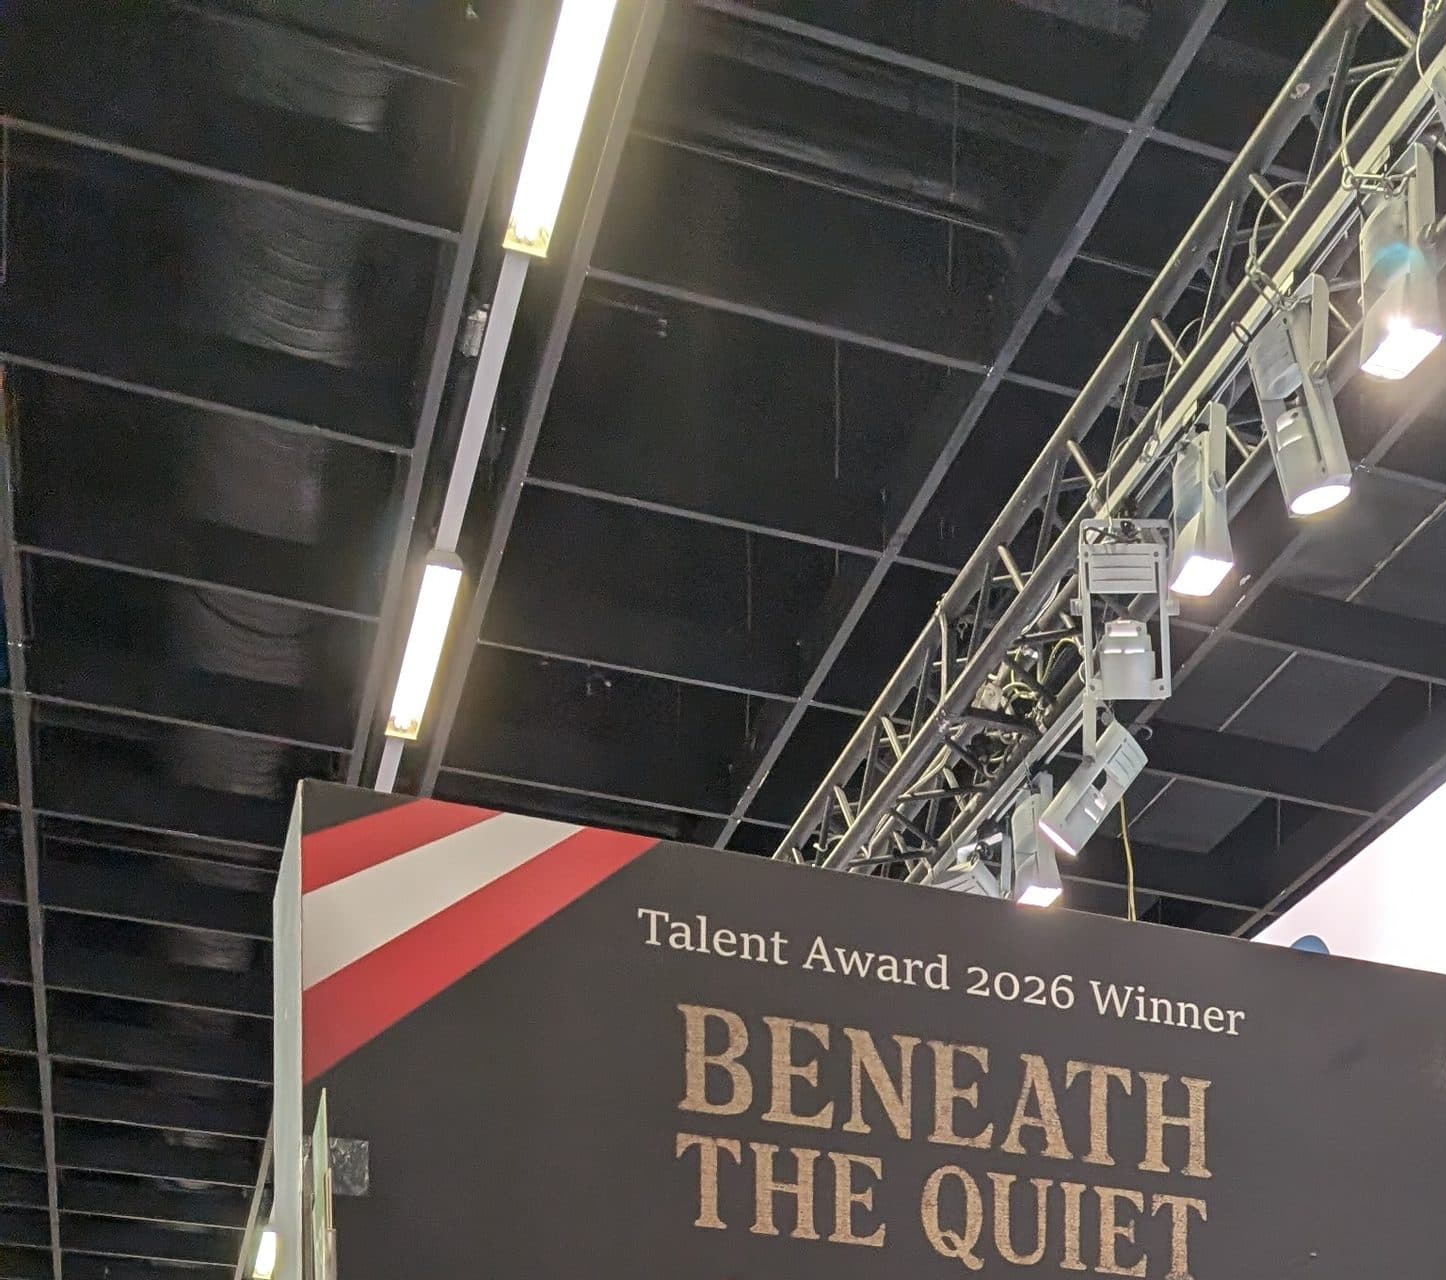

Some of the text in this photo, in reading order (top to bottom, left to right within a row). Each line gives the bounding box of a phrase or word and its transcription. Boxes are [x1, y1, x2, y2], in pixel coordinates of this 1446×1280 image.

[637, 908, 1246, 1036] Talent Award 2026 Winner
[677, 1003, 1214, 1178] BENEATH
[675, 1133, 886, 1247] THE
